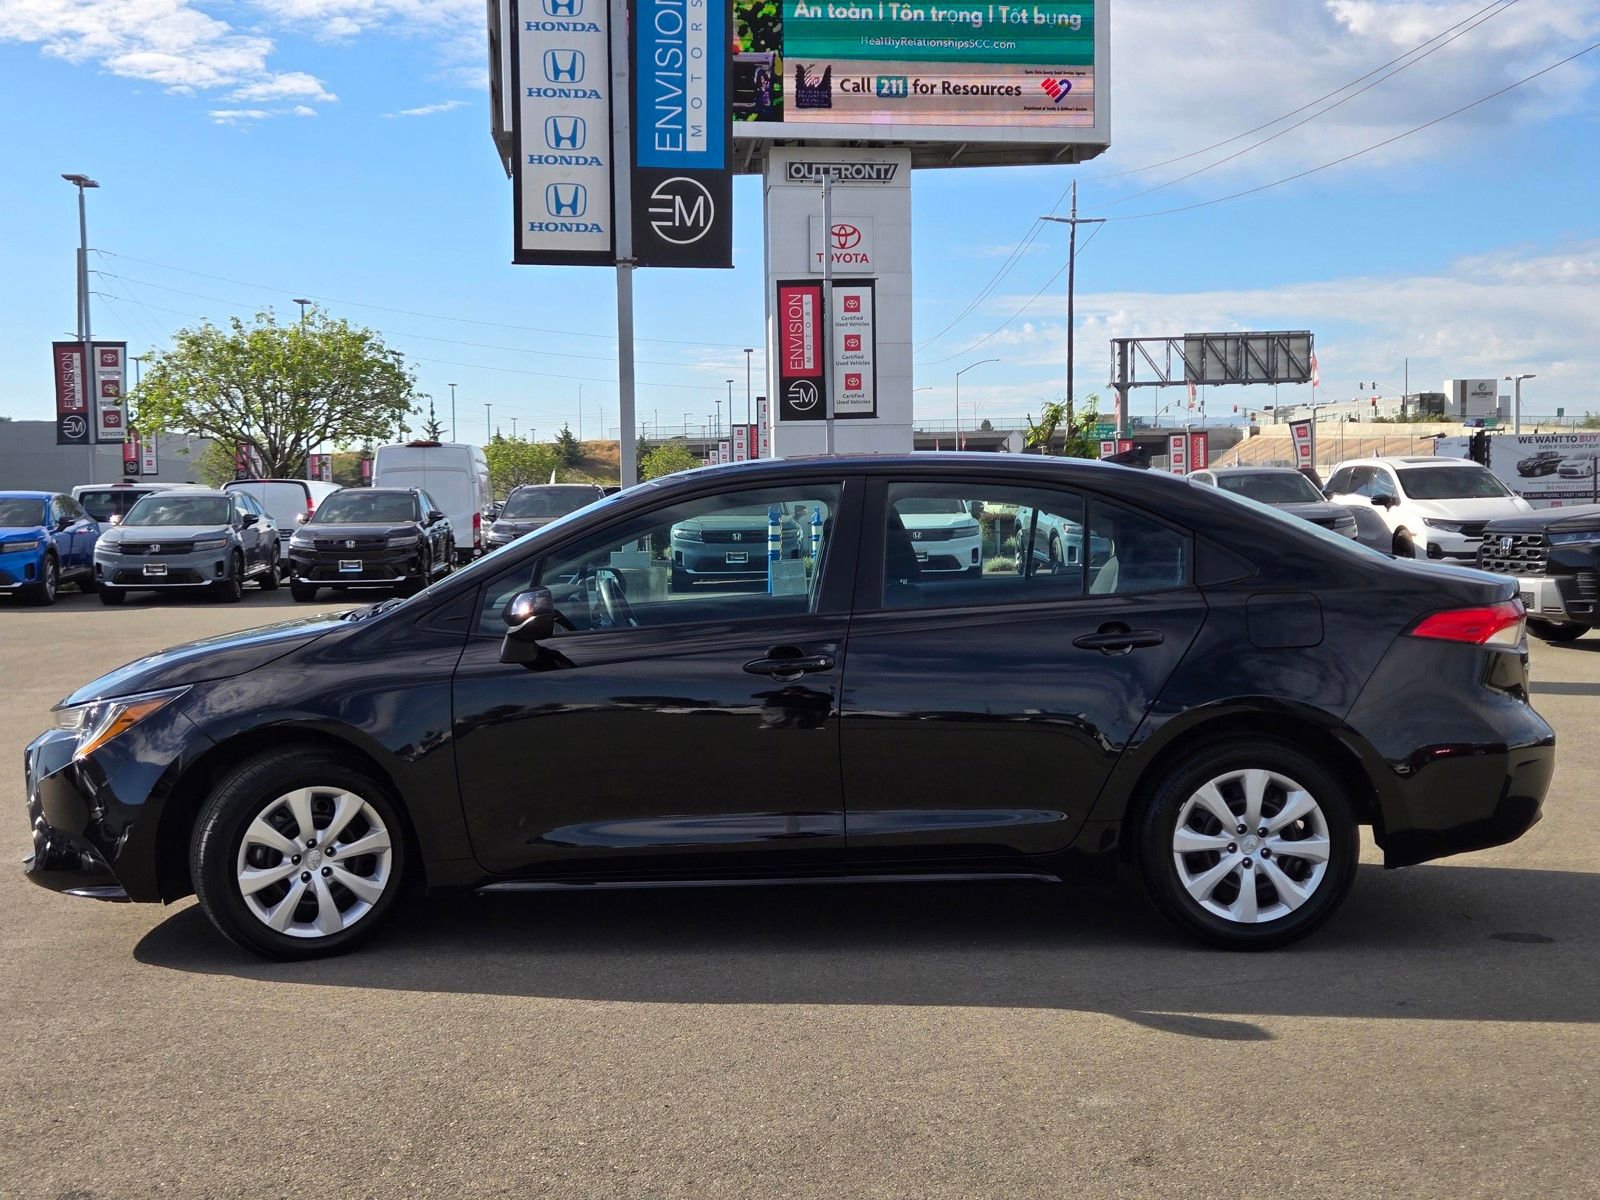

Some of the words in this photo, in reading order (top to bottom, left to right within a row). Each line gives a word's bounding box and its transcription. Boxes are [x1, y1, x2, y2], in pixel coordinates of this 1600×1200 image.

[794, 1, 822, 18] An
[828, 2, 873, 19] toàn
[889, 3, 925, 21] Tôn
[930, 6, 983, 27] trọng
[998, 6, 1028, 24] Tốt
[1033, 6, 1081, 31] bụng
[524, 21, 601, 33] HONDA
[861, 36, 1016, 49] HealthyRelationshipsSCC.com
[526, 87, 602, 99] HONDA
[840, 77, 871, 93] Call
[881, 79, 904, 94] 211
[912, 79, 937, 94] for
[941, 81, 1022, 97] Resources
[527, 154, 603, 166] HONDA
[528, 221, 604, 233] HONDA
[789, 294, 804, 370] ENVISION
[61, 352, 74, 408] ENVISION
[1518, 436, 1533, 444] WE
[1535, 435, 1563, 443] WANT
[1565, 435, 1578, 443] TO
